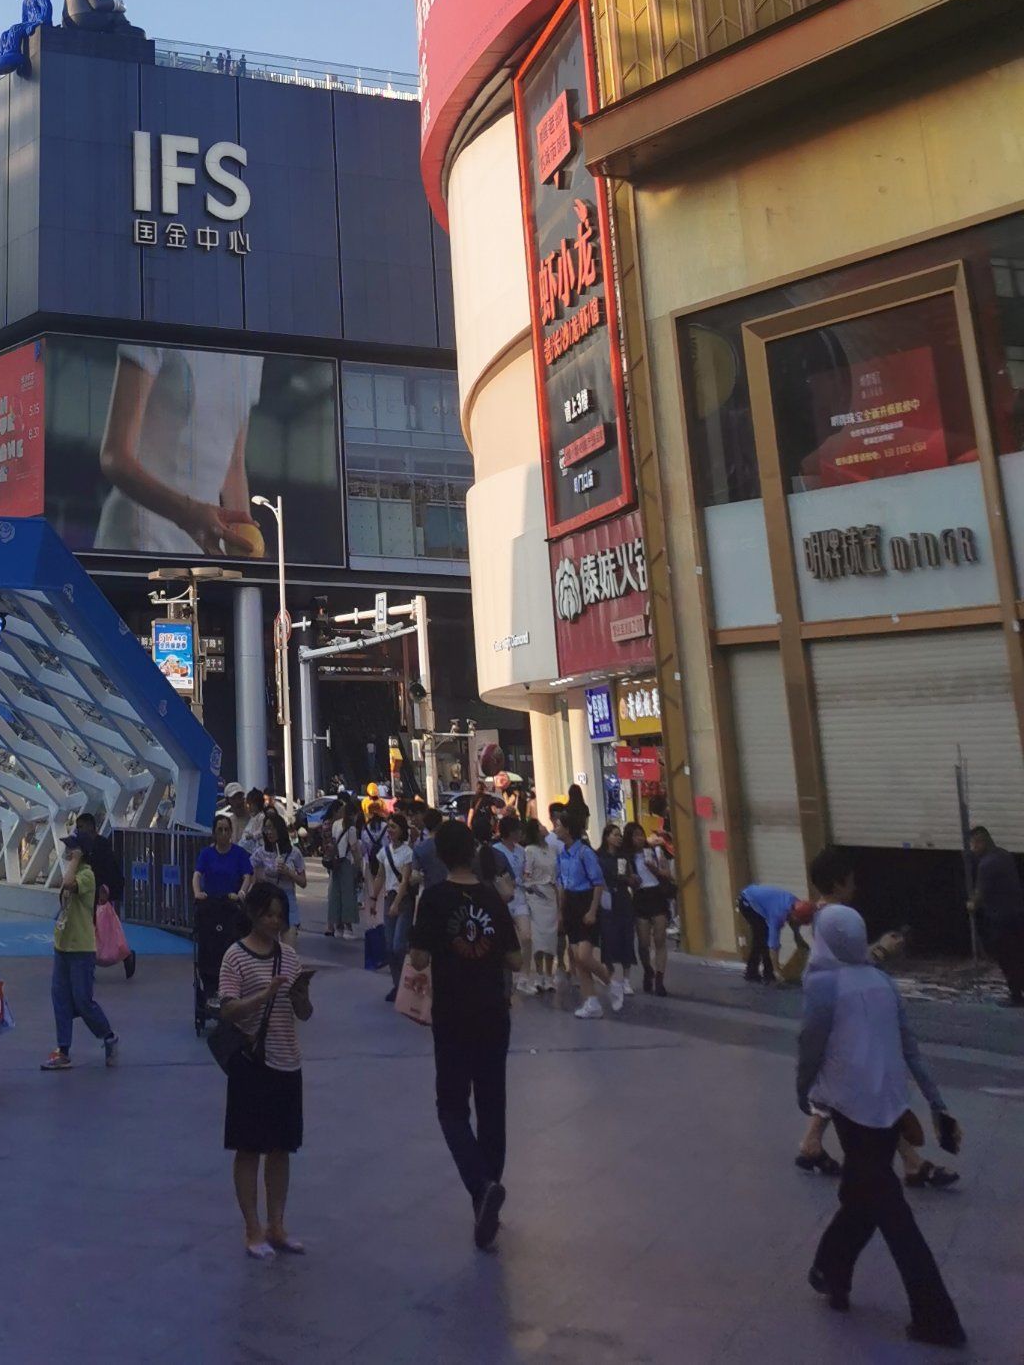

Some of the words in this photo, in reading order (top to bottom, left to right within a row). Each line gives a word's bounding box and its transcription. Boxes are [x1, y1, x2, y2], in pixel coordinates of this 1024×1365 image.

[133, 131, 251, 221] IFS
[134, 219, 252, 255] 国金中心
[539, 198, 597, 325] 虾小龙
[803, 524, 881, 580] 明牌珠宝
